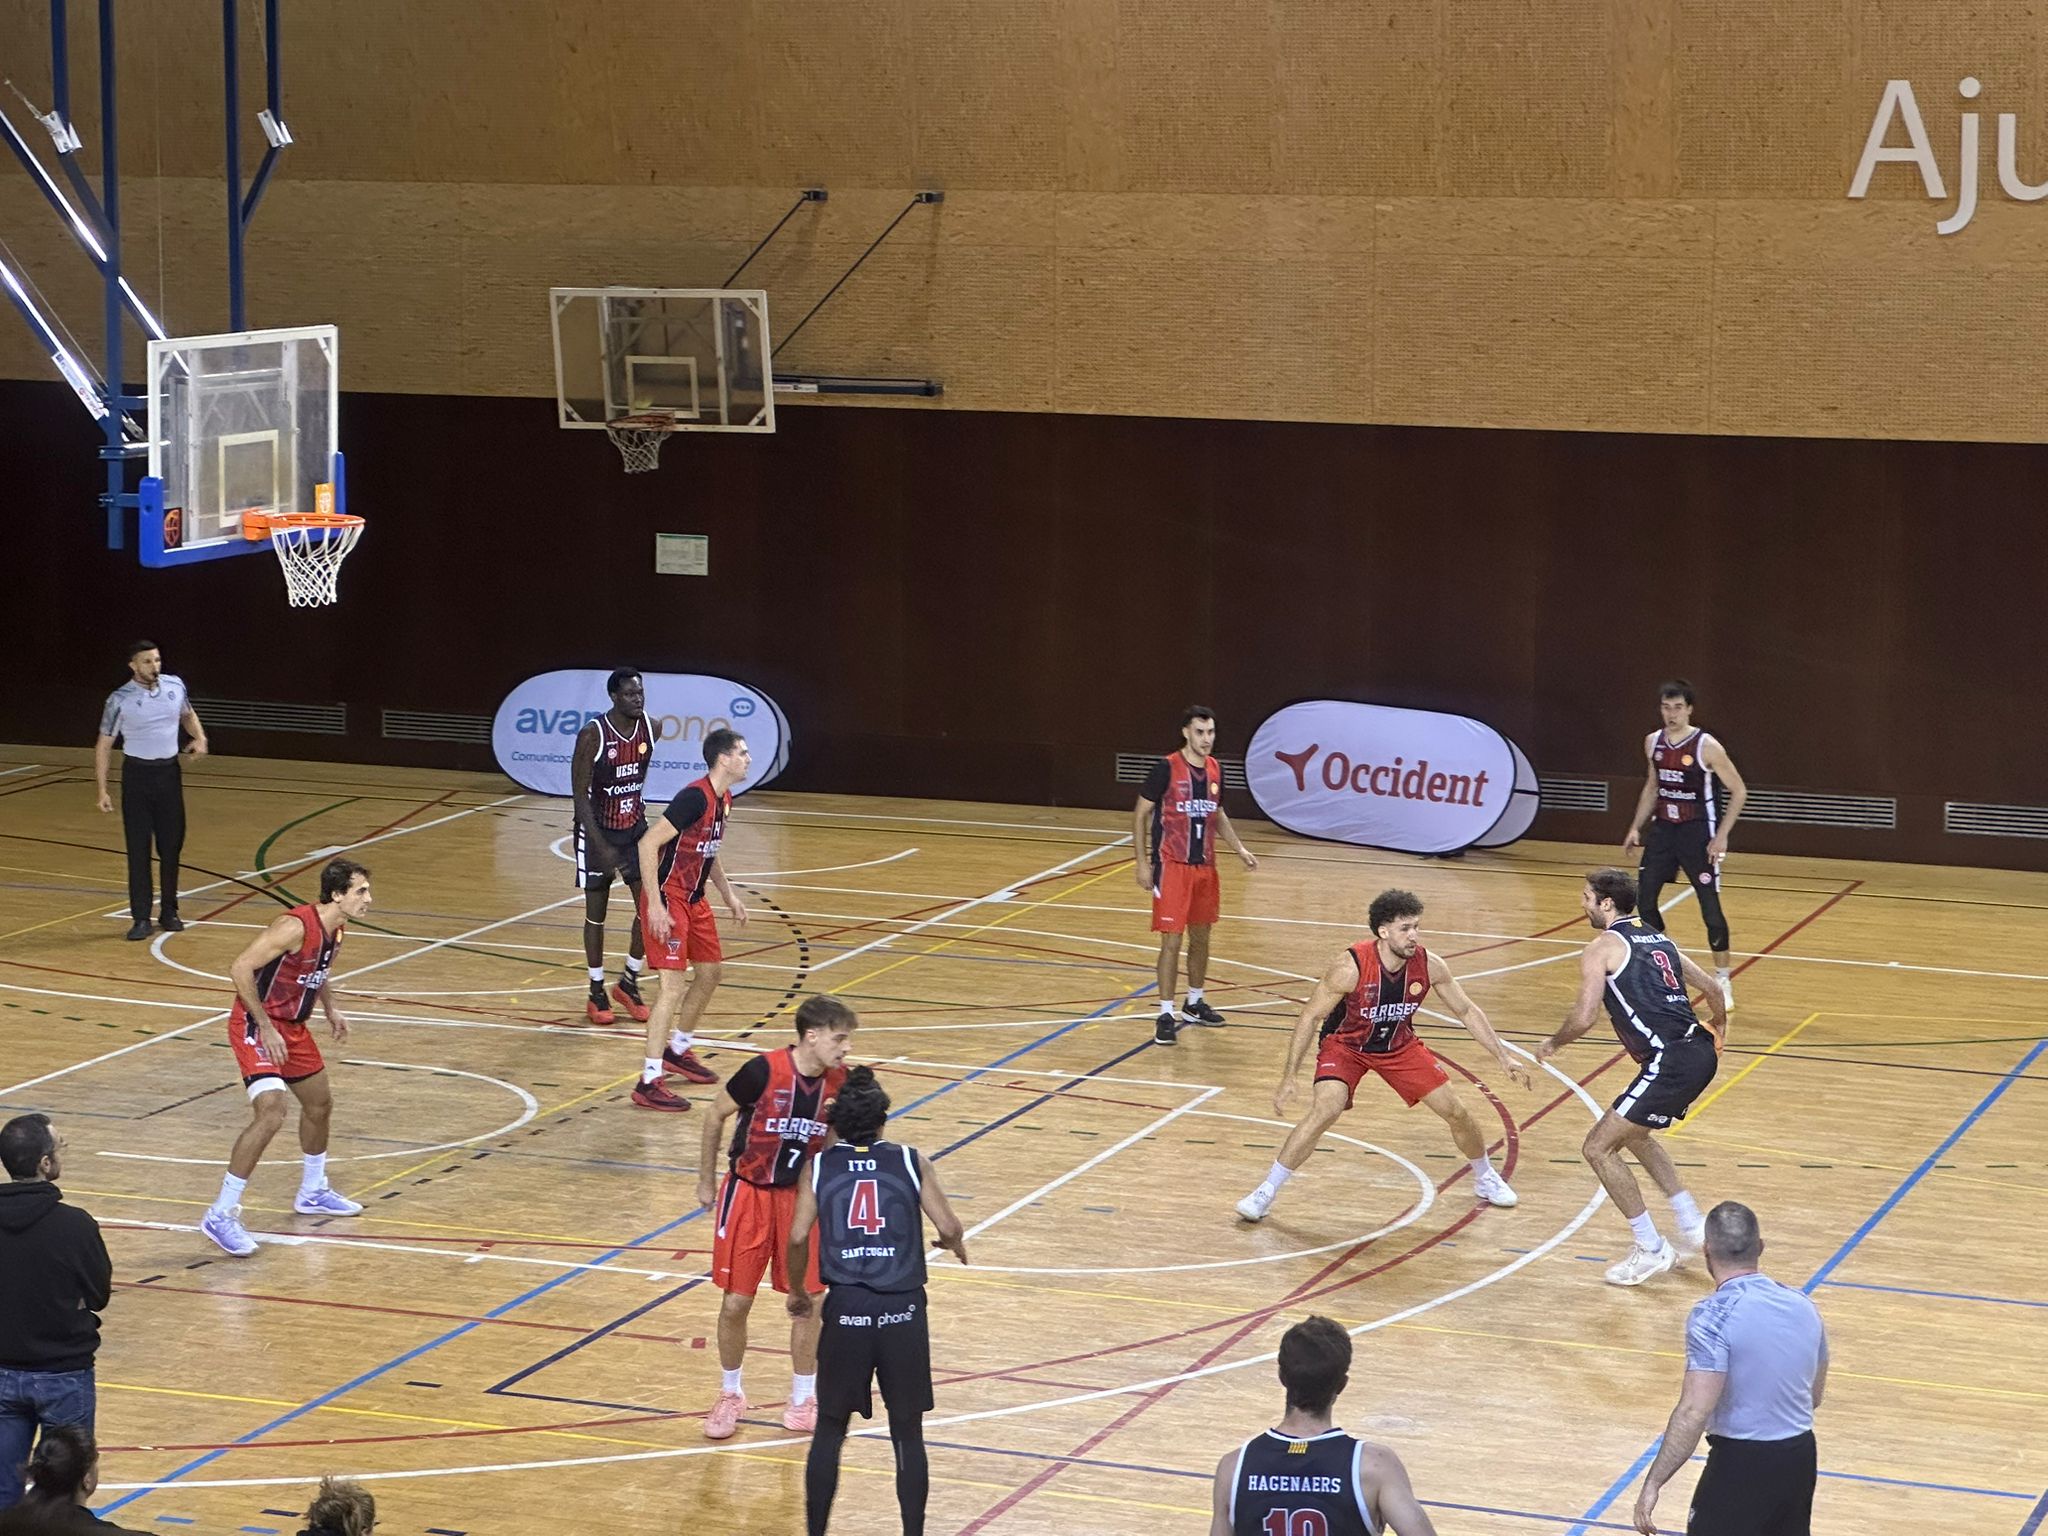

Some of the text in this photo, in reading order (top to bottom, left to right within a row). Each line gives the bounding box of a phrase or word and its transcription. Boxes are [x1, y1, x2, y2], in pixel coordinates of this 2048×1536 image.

[616, 762, 640, 778] UESC
[1322, 751, 1489, 807] Occident
[614, 782, 643, 795] Occide
[787, 1148, 801, 1169] 7
[847, 1159, 877, 1172] ITO
[847, 1179, 886, 1235] 4
[865, 1247, 896, 1257] CUGAT
[839, 1310, 913, 1329] avan phone
[1247, 1475, 1342, 1494] HAGENAERS
